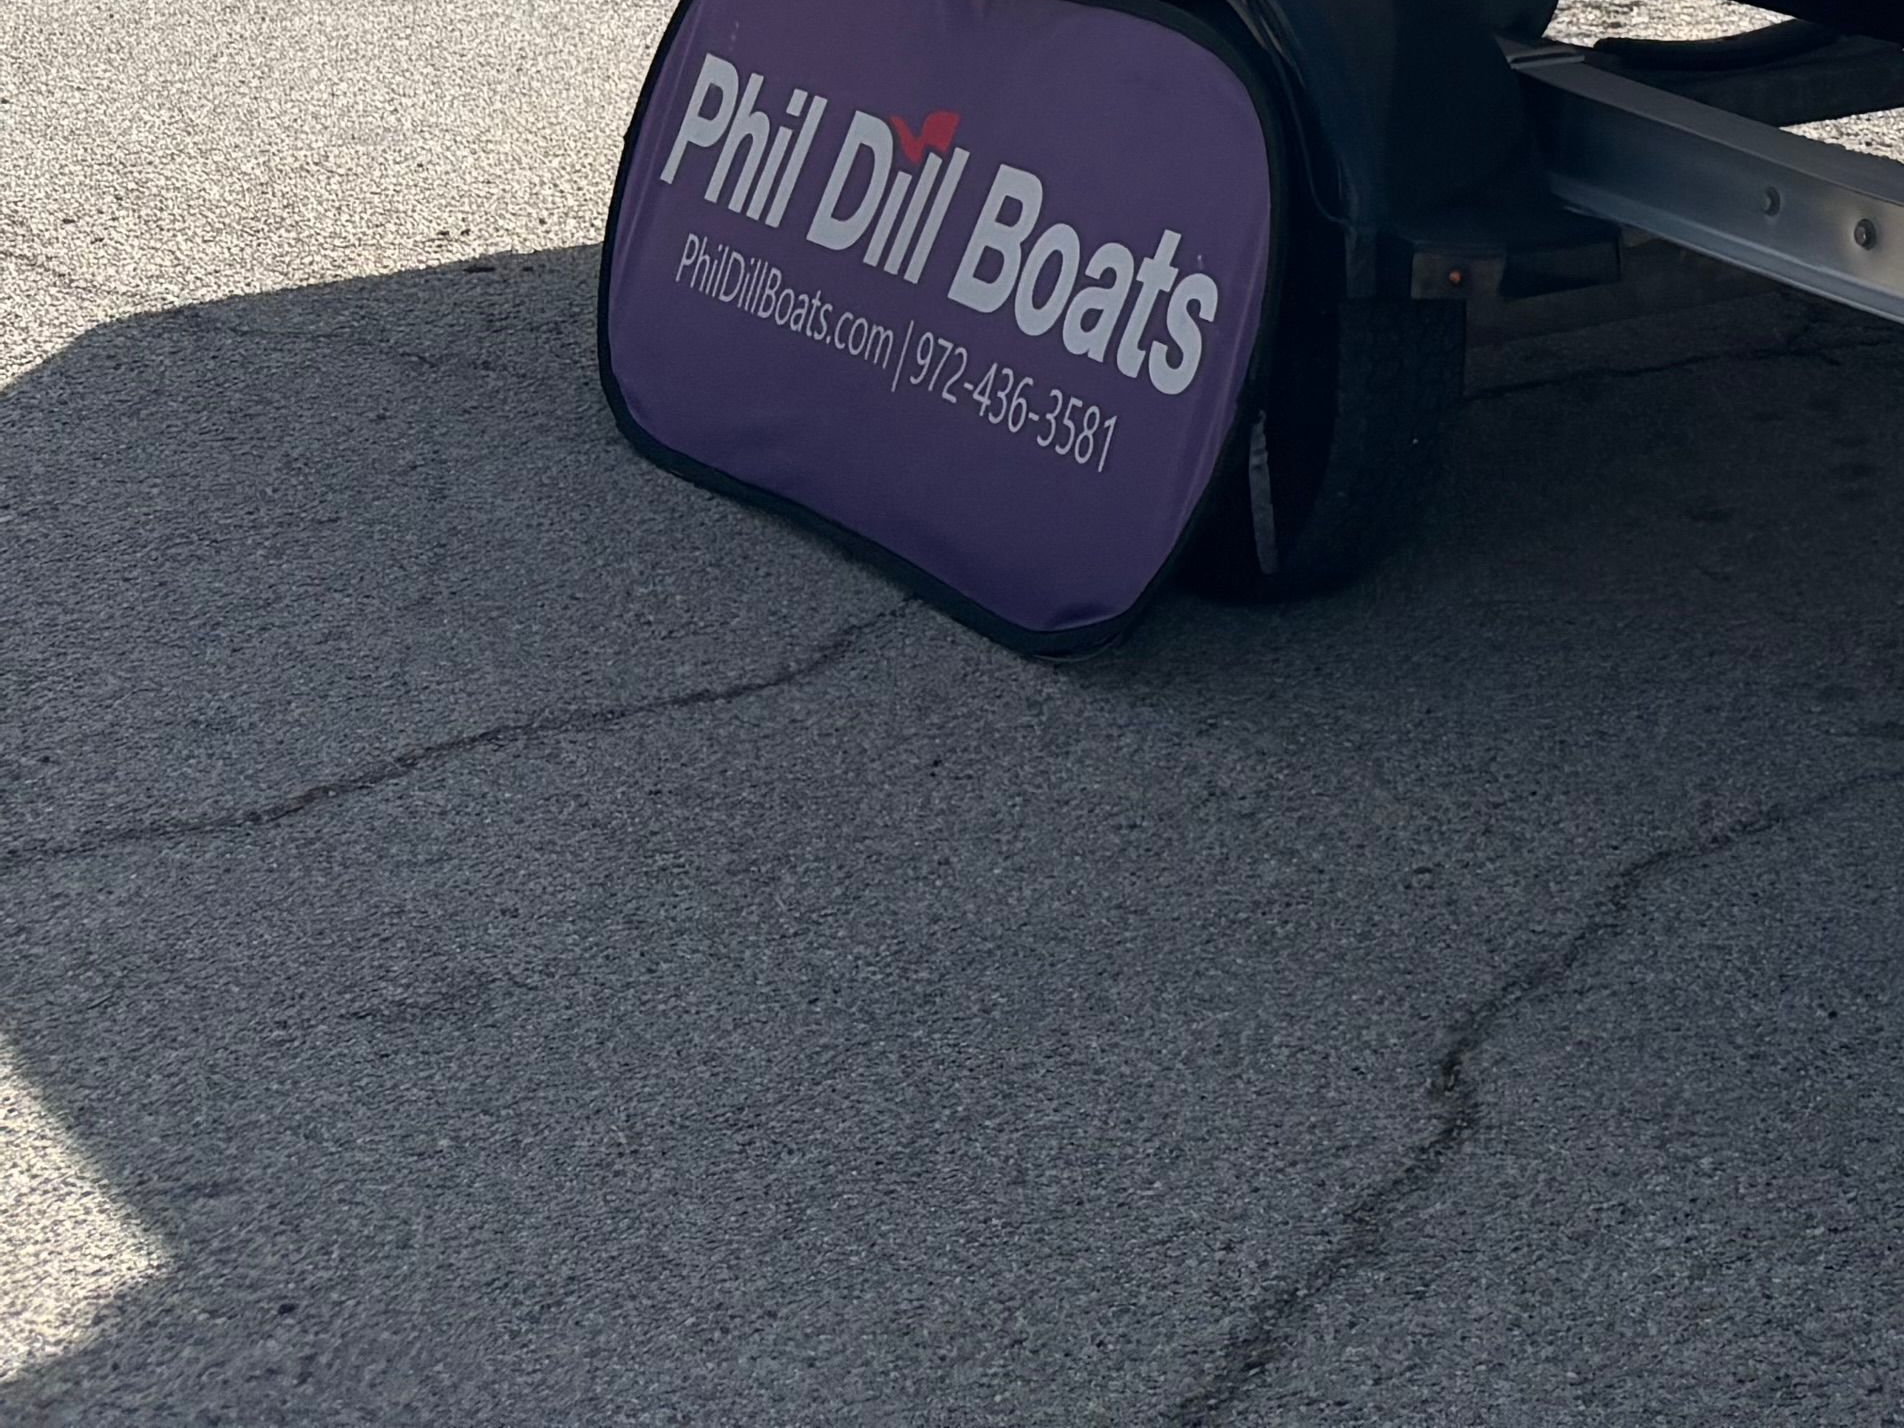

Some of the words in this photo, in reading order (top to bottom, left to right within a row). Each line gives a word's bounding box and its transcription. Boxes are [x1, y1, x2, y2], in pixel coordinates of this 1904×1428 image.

[660, 53, 828, 228] Phil
[806, 110, 970, 284] Dill
[948, 164, 1218, 394] Boats
[676, 233, 893, 370] PhilDillBoats.com
[910, 331, 1118, 473] 972-436-3581
